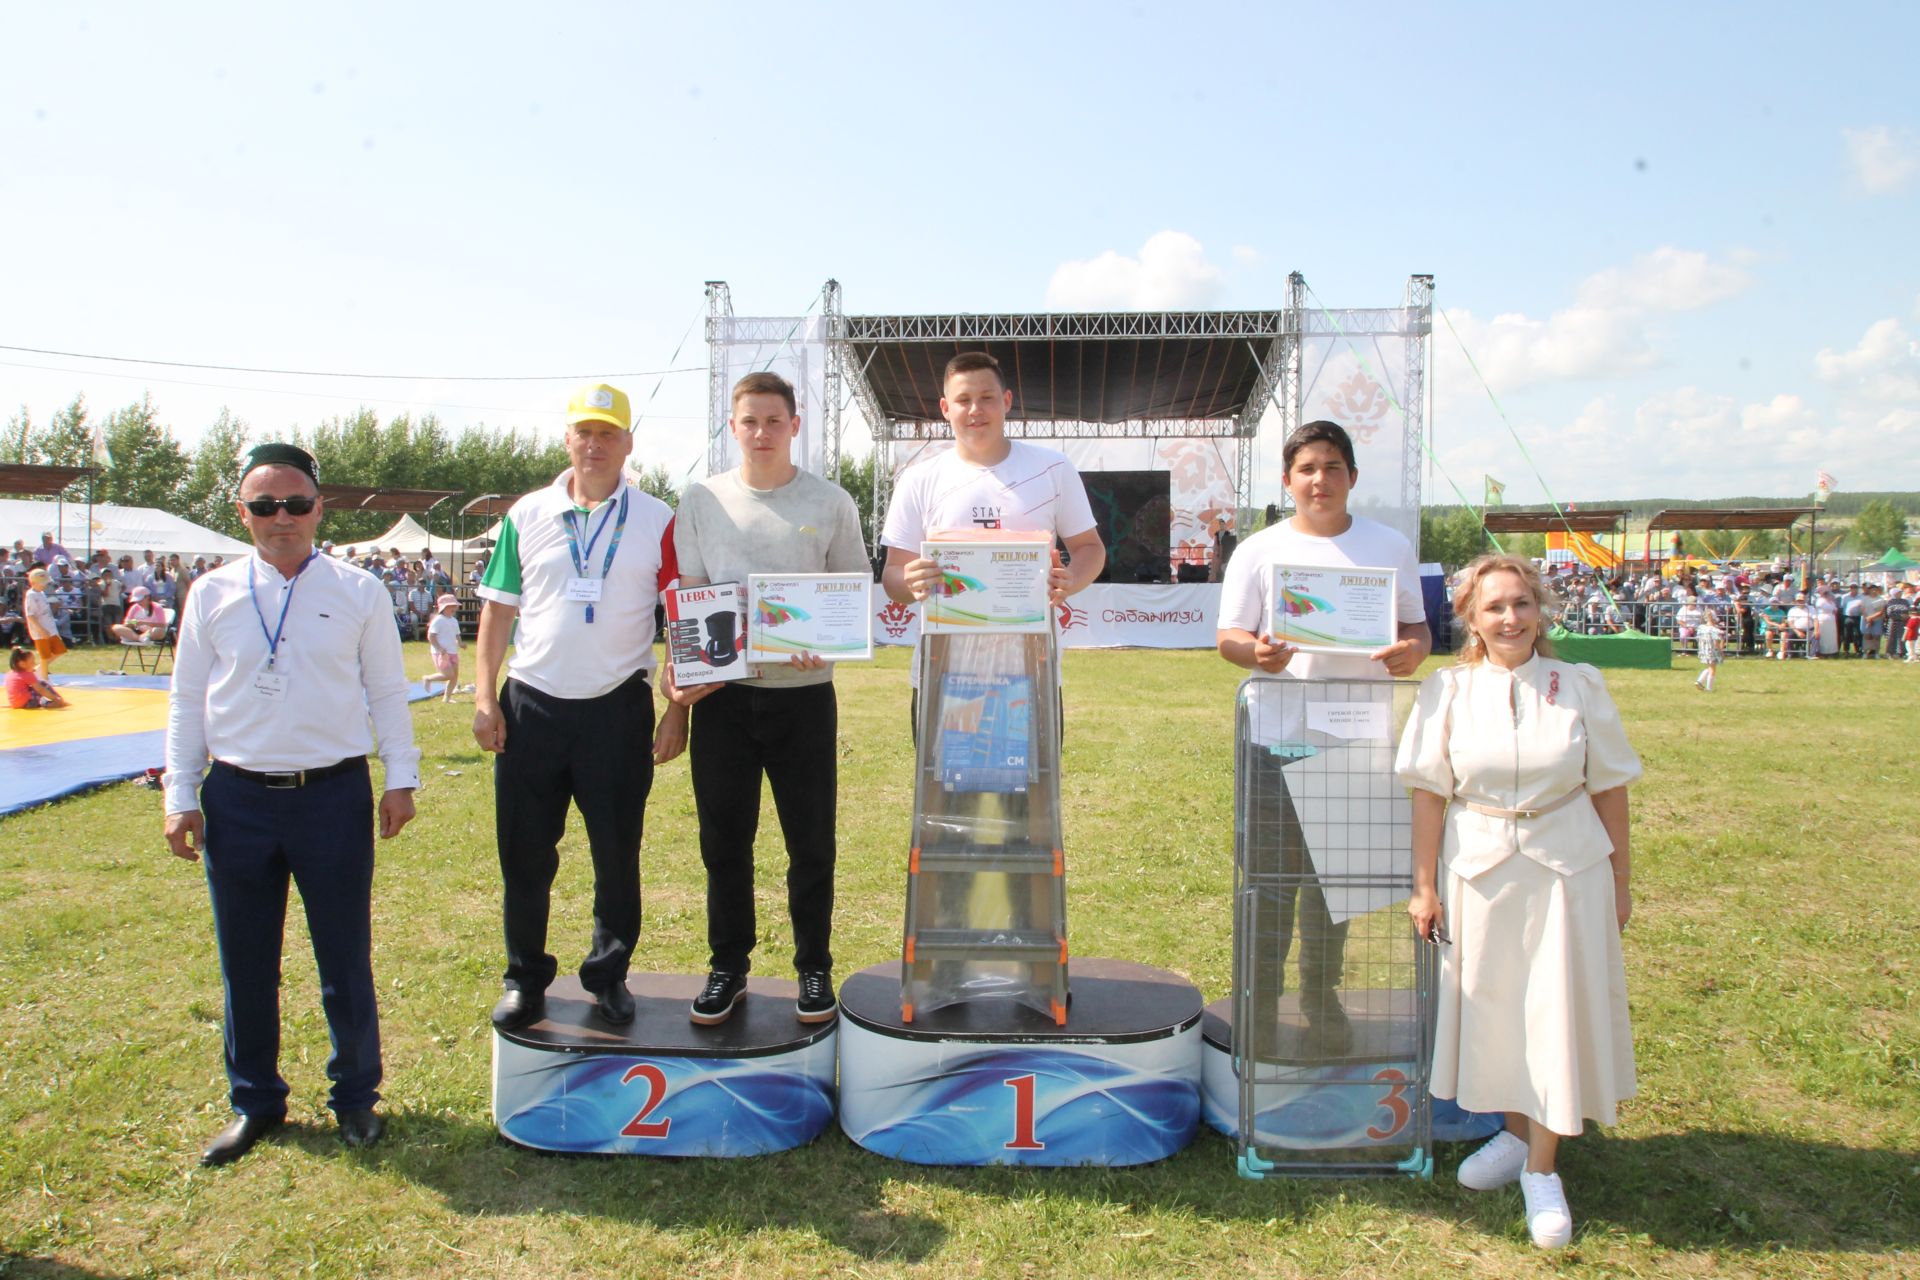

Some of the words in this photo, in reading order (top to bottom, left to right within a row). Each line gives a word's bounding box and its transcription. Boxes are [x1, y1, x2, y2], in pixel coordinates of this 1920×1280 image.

[972, 506, 1002, 518] STAY
[991, 552, 1039, 563] ДИПЛОМ
[815, 582, 862, 593] ДИПЛОМ
[1340, 575, 1388, 587] ДИПЛОМ
[680, 589, 716, 603] LEBEN
[1102, 608, 1204, 625] Сабантуй
[677, 668, 714, 679] Кофеварка
[620, 1063, 672, 1139] 2
[1366, 1067, 1410, 1140] 3
[1003, 1073, 1045, 1150] 1
